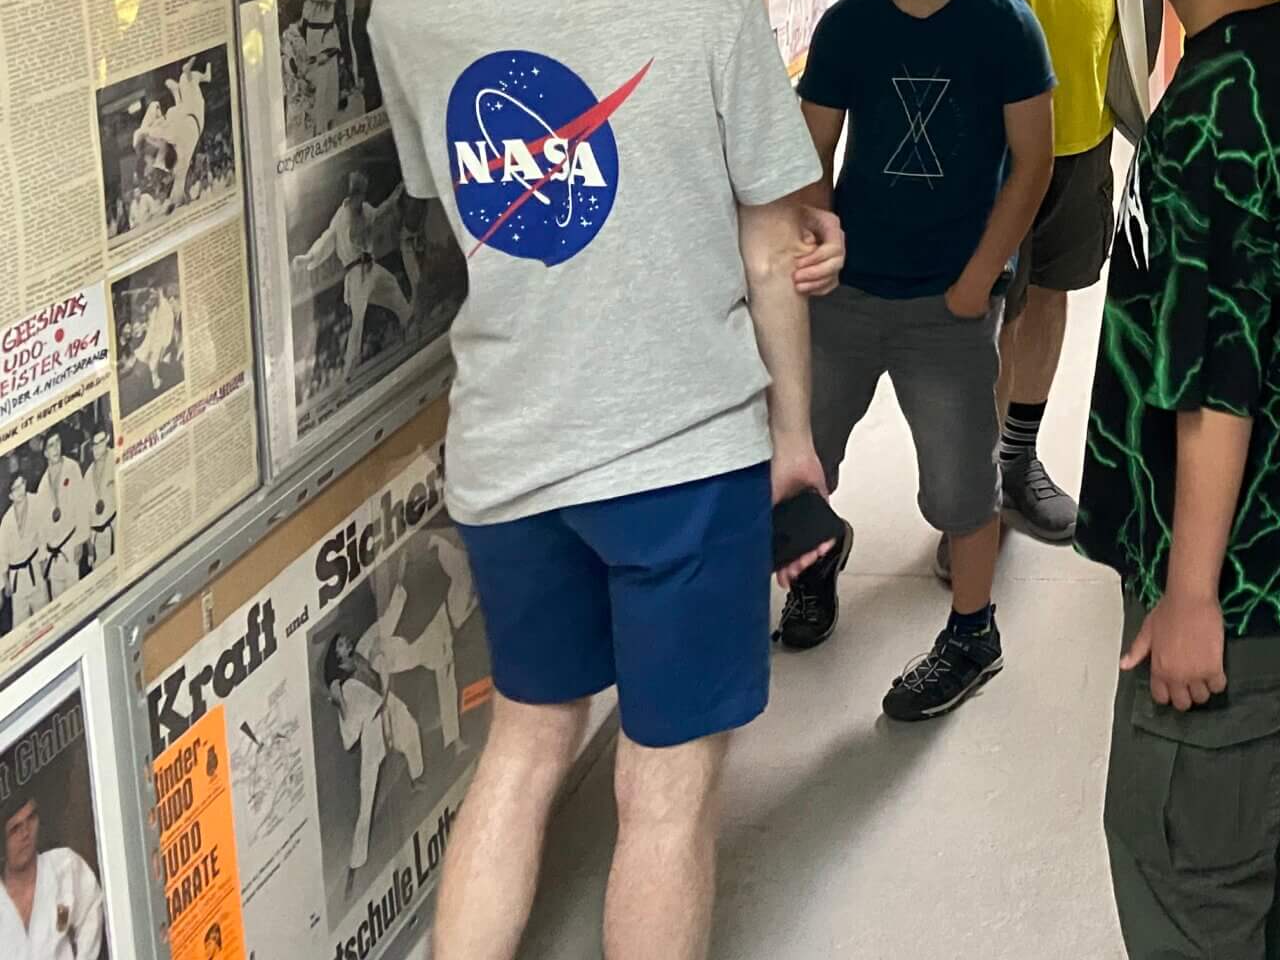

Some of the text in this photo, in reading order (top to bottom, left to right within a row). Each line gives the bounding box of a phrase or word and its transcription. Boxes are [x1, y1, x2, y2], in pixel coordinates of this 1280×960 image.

[454, 138, 608, 187] NASA
[146, 442, 446, 762] Kraft und Sicher
[15, 704, 83, 786] Glahn
[154, 737, 208, 798] inder-
[166, 843, 221, 928] ARATE
